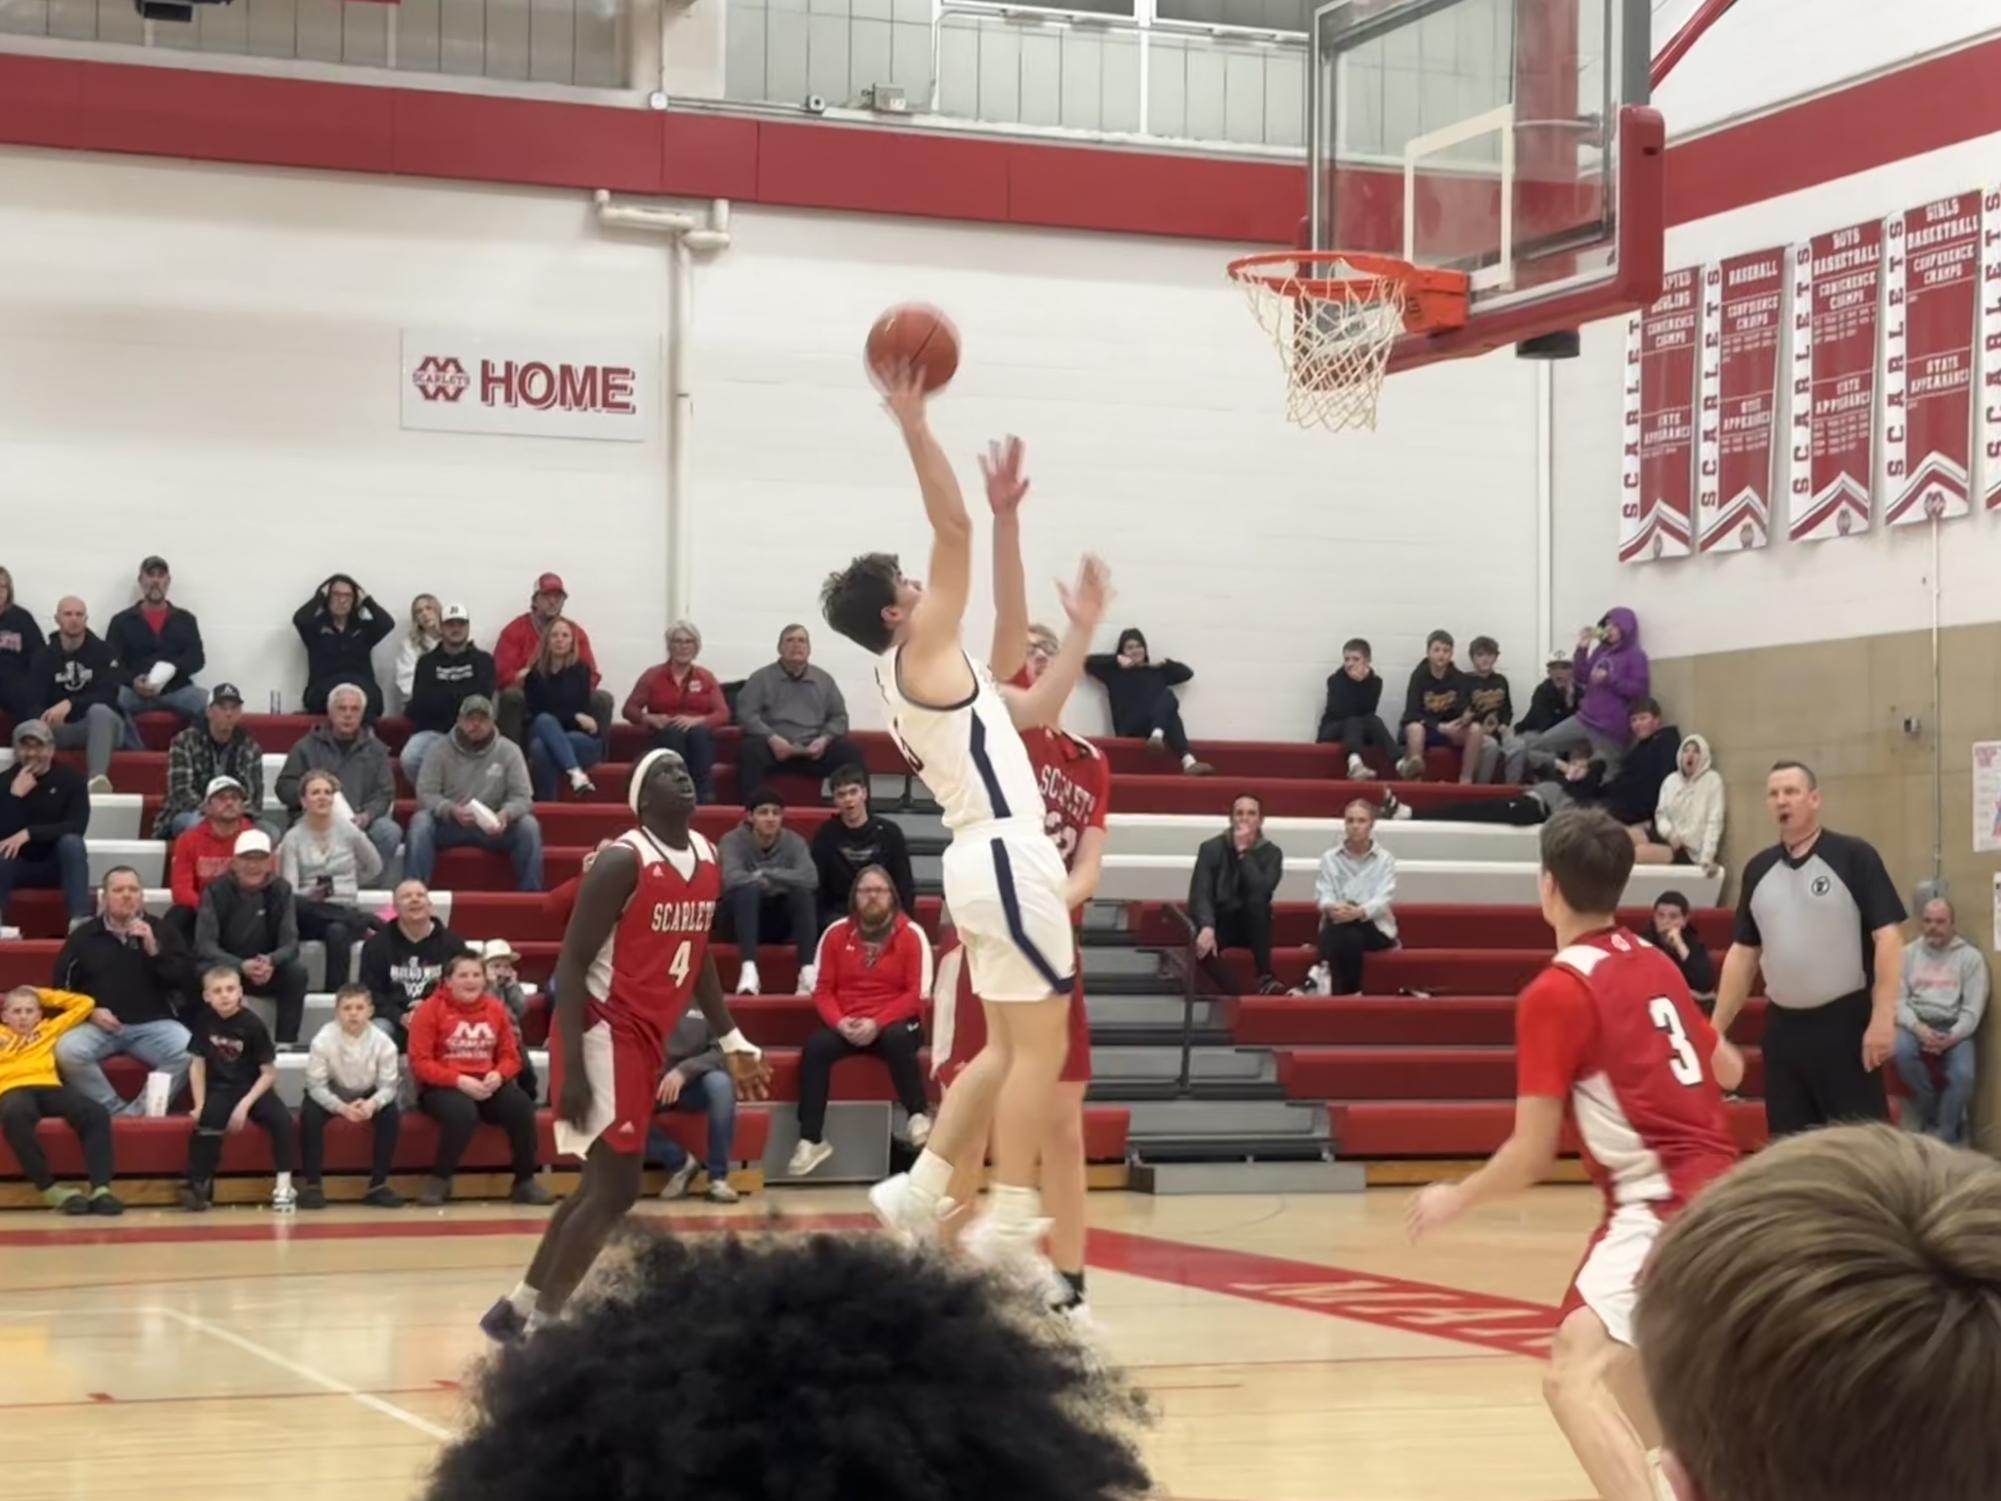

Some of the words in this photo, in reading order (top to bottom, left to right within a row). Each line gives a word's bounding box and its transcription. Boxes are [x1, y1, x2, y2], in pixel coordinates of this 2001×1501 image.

[1814, 242, 1880, 276] BASKETBALL
[1907, 214, 1978, 249] BASKETBALL
[1729, 260, 1778, 286] BASEBALL
[1793, 248, 1811, 493] SCARLETS
[1887, 221, 1905, 476] SCARLETS
[480, 359, 635, 414] HOME
[1623, 320, 1639, 518] SCARLET
[1701, 270, 1720, 506] SCARLETS
[668, 941, 691, 988] 4
[1649, 997, 1703, 1085] 3
